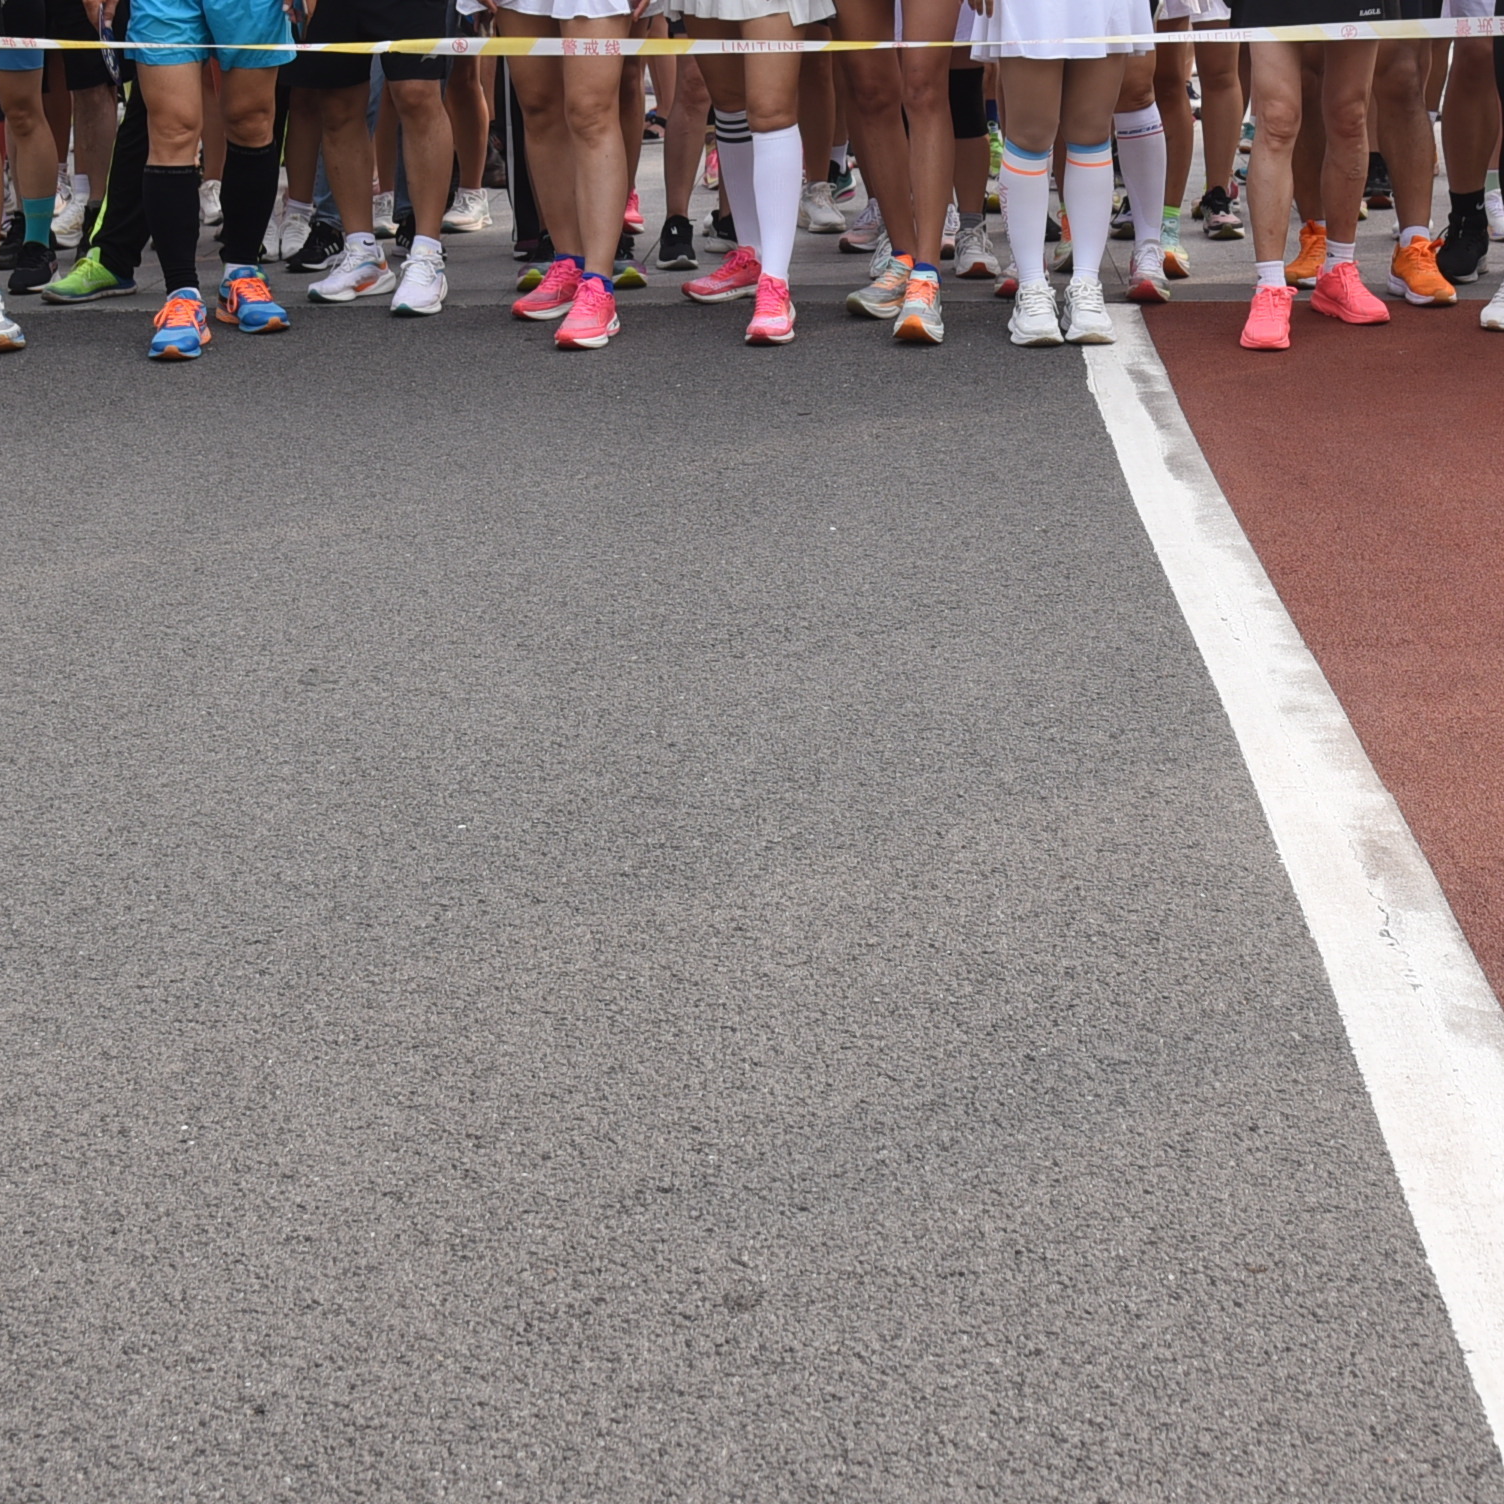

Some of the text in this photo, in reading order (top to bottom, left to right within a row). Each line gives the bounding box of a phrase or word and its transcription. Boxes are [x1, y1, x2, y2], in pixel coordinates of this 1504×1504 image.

[1359, 8, 1381, 17] EAGLE
[561, 39, 621, 55] 警戒线
